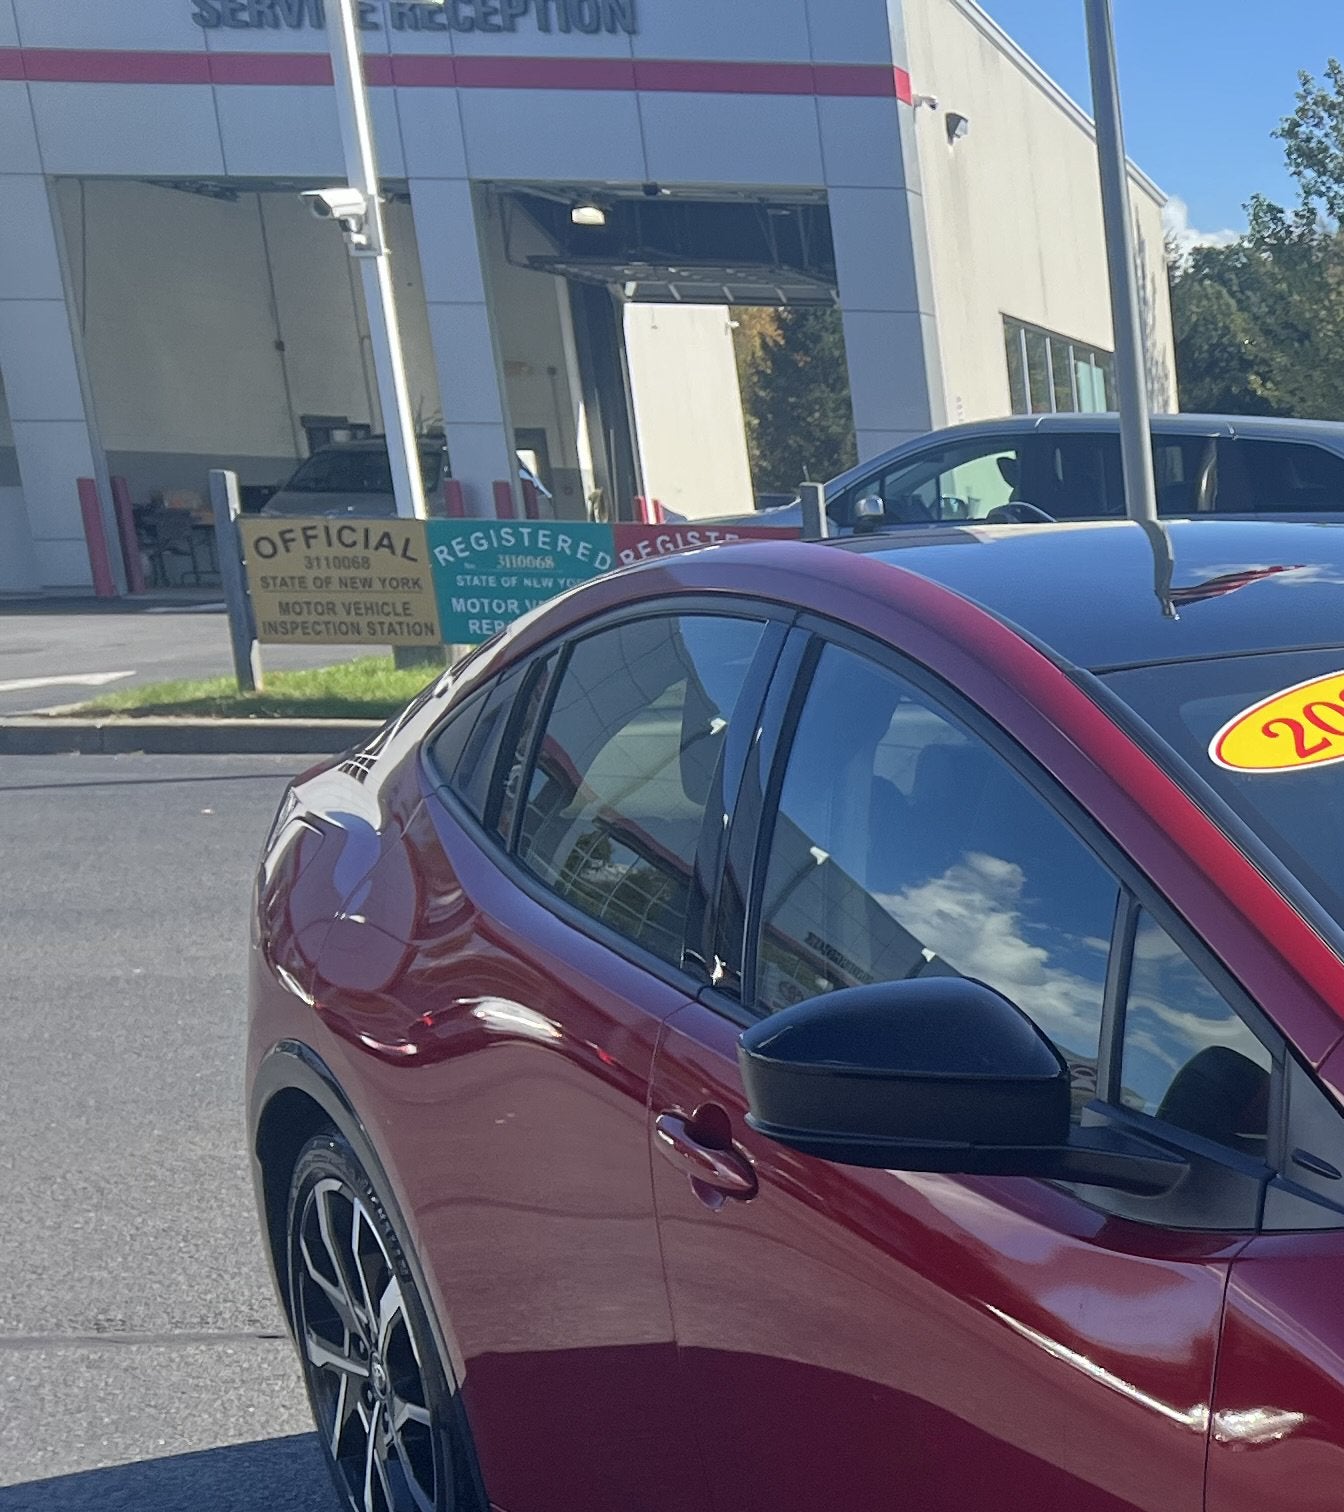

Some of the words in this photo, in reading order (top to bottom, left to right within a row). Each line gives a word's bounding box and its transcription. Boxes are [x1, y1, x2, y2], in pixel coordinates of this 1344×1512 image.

[192, 0, 380, 29] SERVIE
[390, 0, 637, 34] RECEPTION
[253, 525, 419, 562] OFFICIAL
[433, 527, 612, 570] REGISTERED
[304, 556, 371, 570] 3110068
[496, 554, 555, 570] 3110068
[260, 576, 308, 590] STATE
[313, 576, 332, 590] OF
[338, 577, 373, 590] NEW
[378, 577, 423, 590] YORK
[456, 575, 497, 587] STATE
[501, 576, 518, 588] OF
[523, 577, 553, 588] NEW
[278, 601, 337, 617] MOTOR
[342, 601, 413, 617] VEHICLE
[452, 598, 520, 614] MOTOR
[262, 620, 361, 636] INSPECTION
[367, 621, 435, 637] STATION
[469, 619, 511, 635] REP
